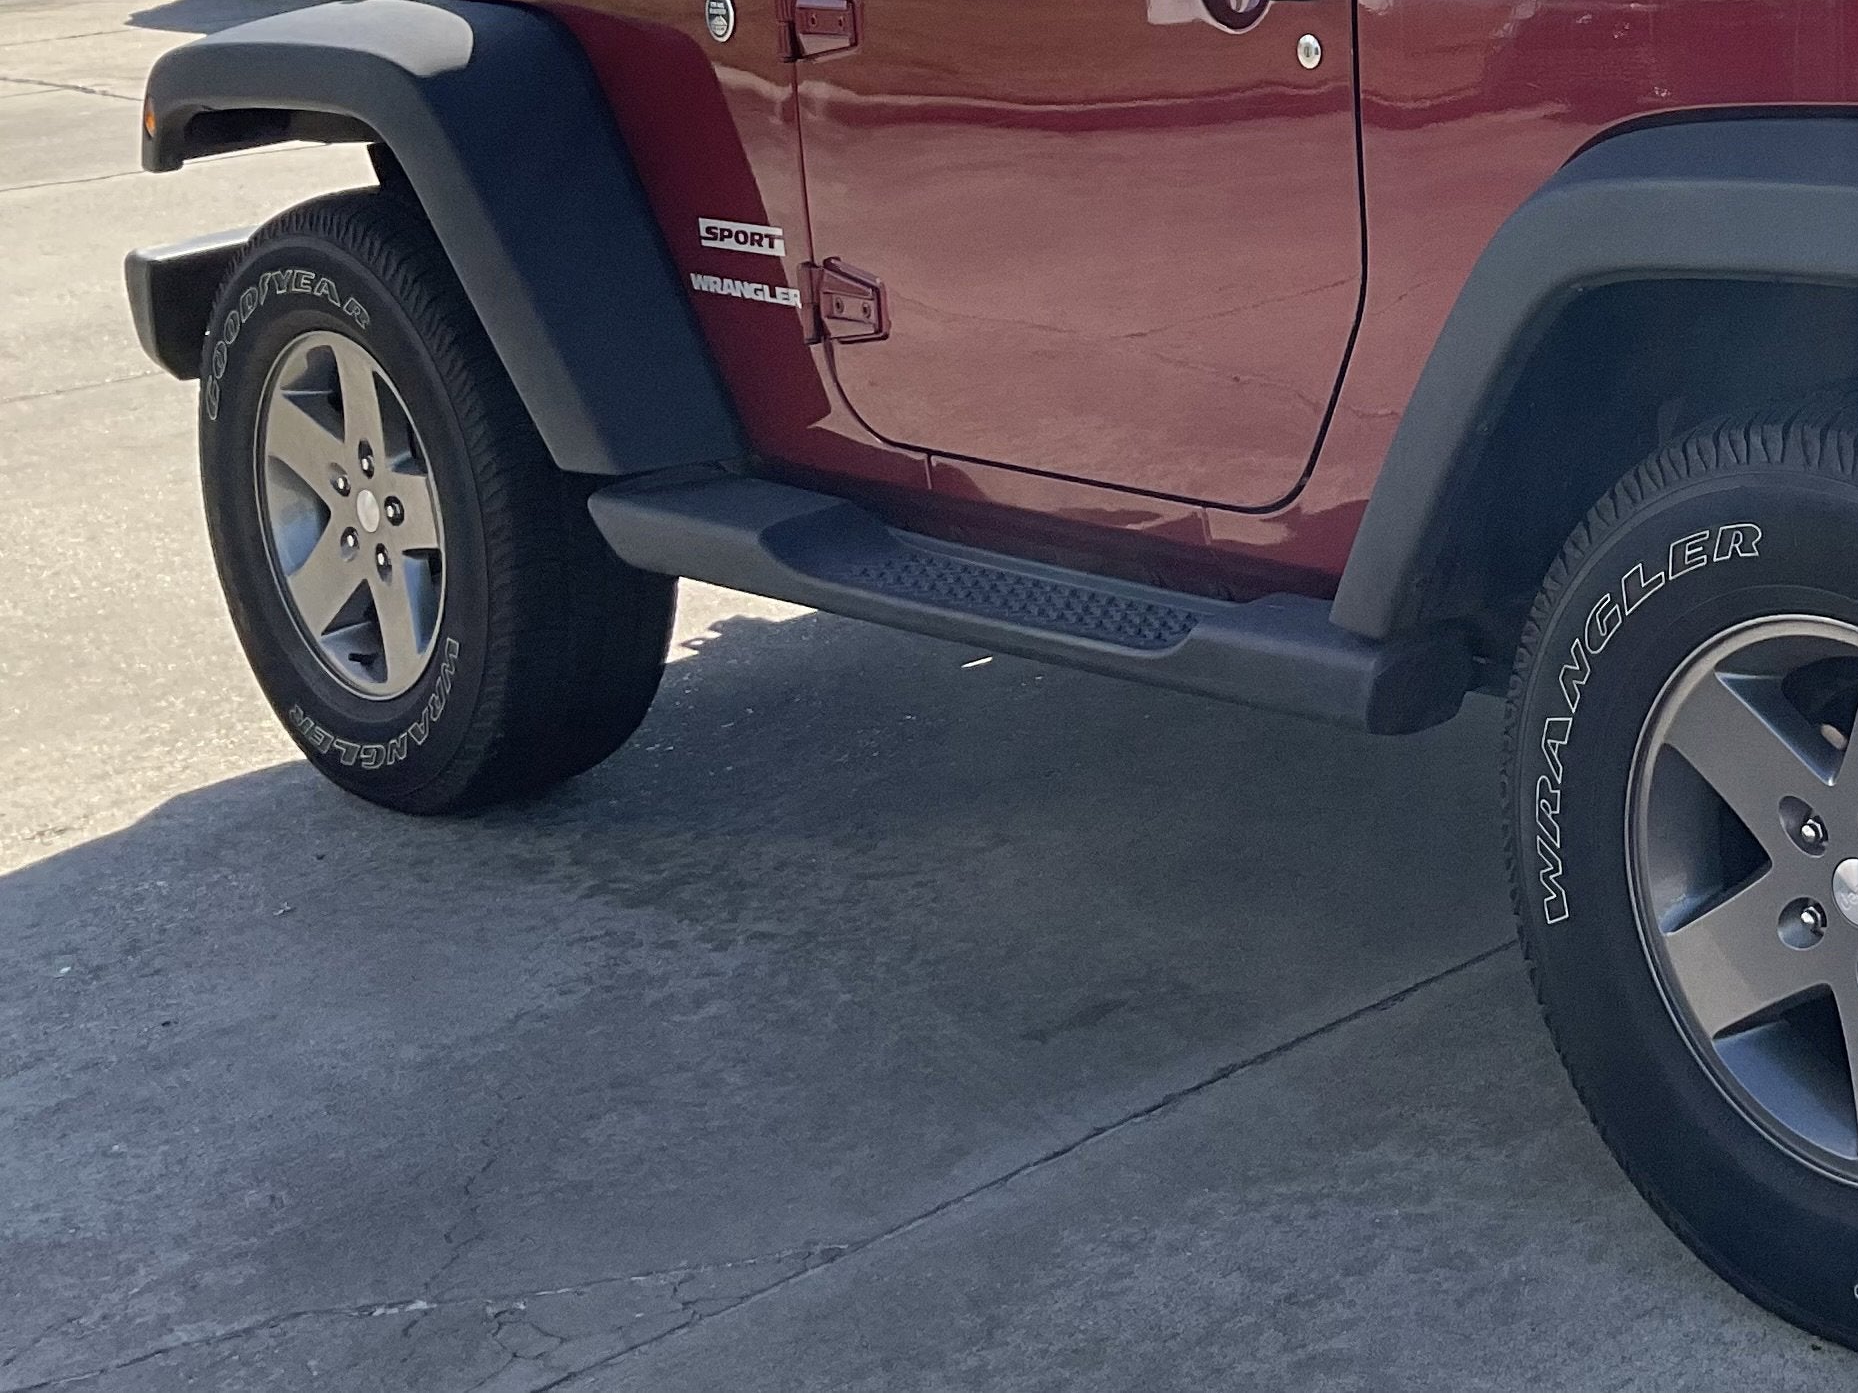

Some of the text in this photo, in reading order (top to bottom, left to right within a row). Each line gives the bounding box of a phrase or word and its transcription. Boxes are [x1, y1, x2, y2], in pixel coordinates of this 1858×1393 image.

[689, 272, 802, 309] WRANGLER
[699, 226, 784, 249] SPORT
[206, 269, 370, 420] GOODYEAR
[289, 637, 460, 770] WRANGLER
[1536, 522, 1763, 925] WRANGLER
